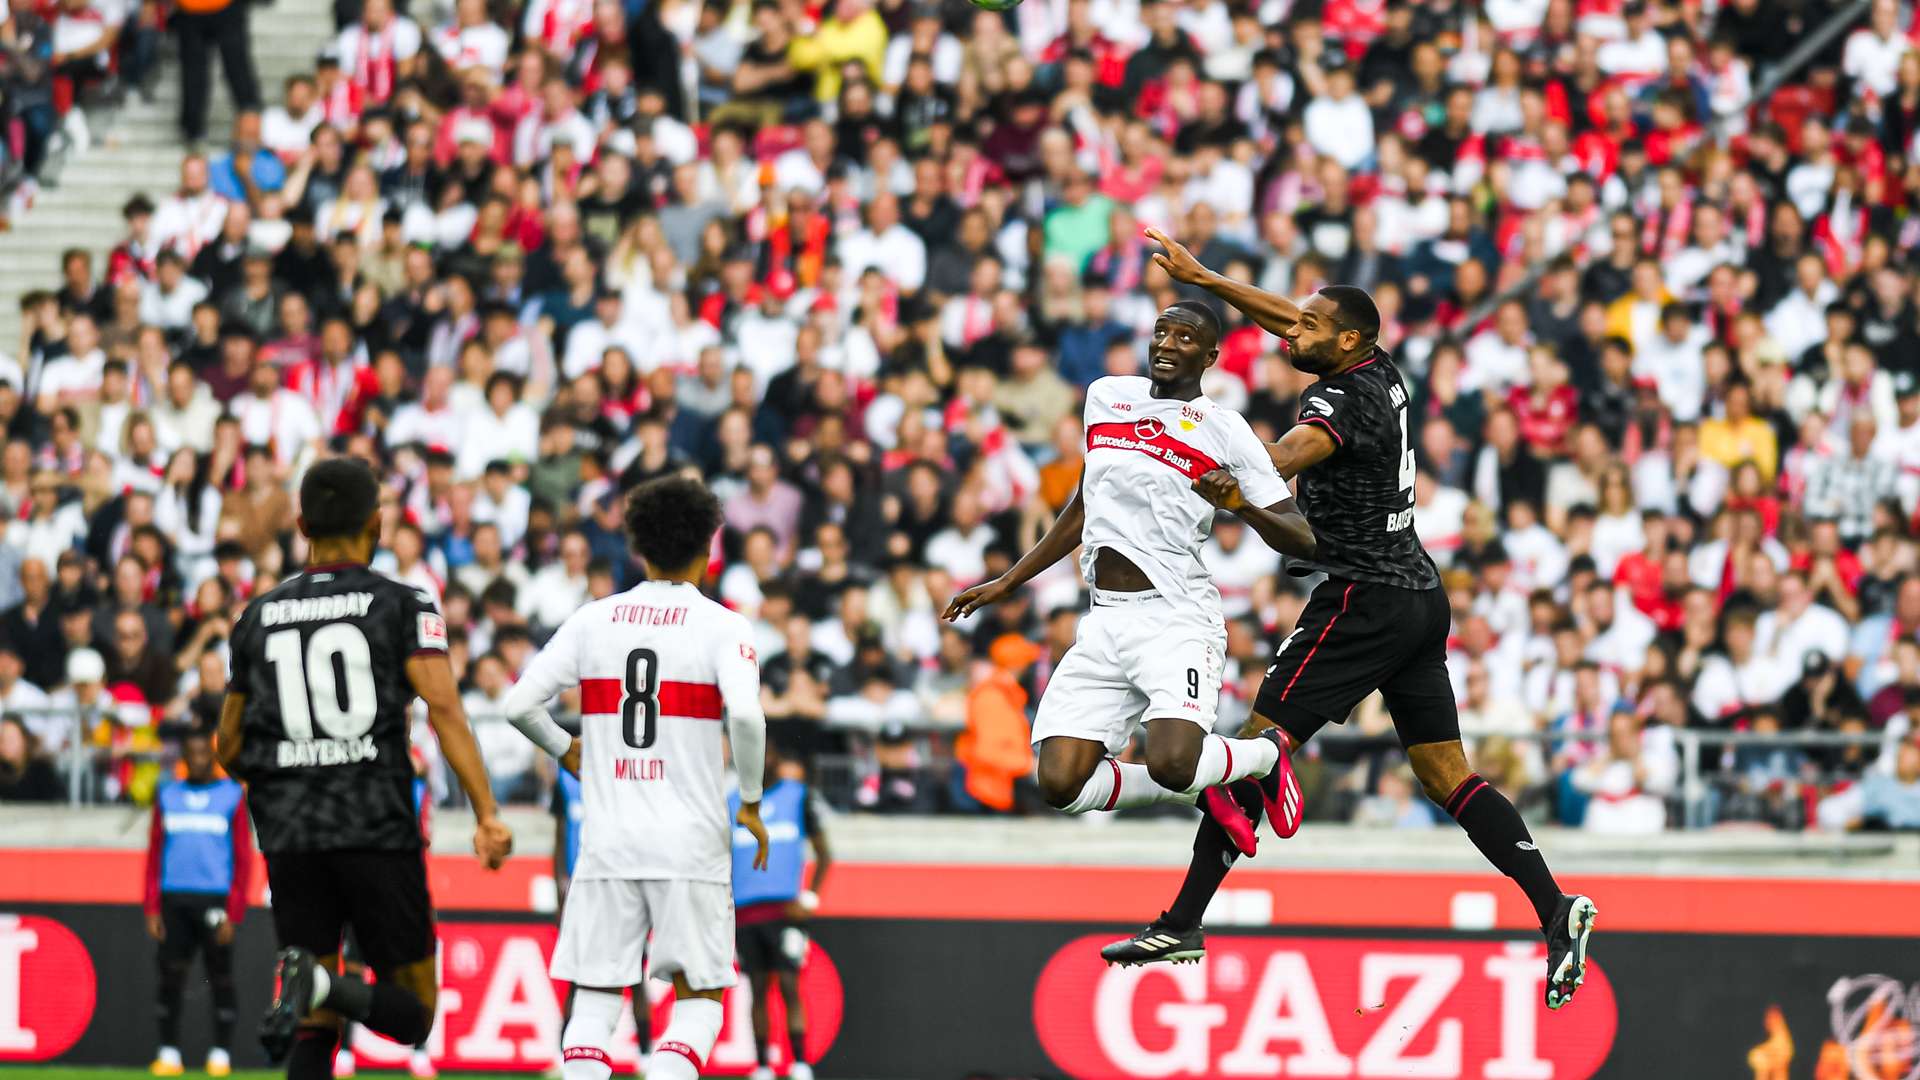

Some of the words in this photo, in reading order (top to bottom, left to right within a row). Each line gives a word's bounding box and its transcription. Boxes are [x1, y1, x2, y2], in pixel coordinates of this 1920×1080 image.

[1111, 402, 1132, 412] JAKO
[1092, 434, 1163, 456] Mercedes-Benz
[1162, 447, 1193, 472] Bank
[611, 604, 689, 627] STUTTGART
[264, 622, 379, 743] 10
[1187, 668, 1199, 699] 9
[622, 648, 659, 750] 8
[614, 757, 665, 782] MILLOT
